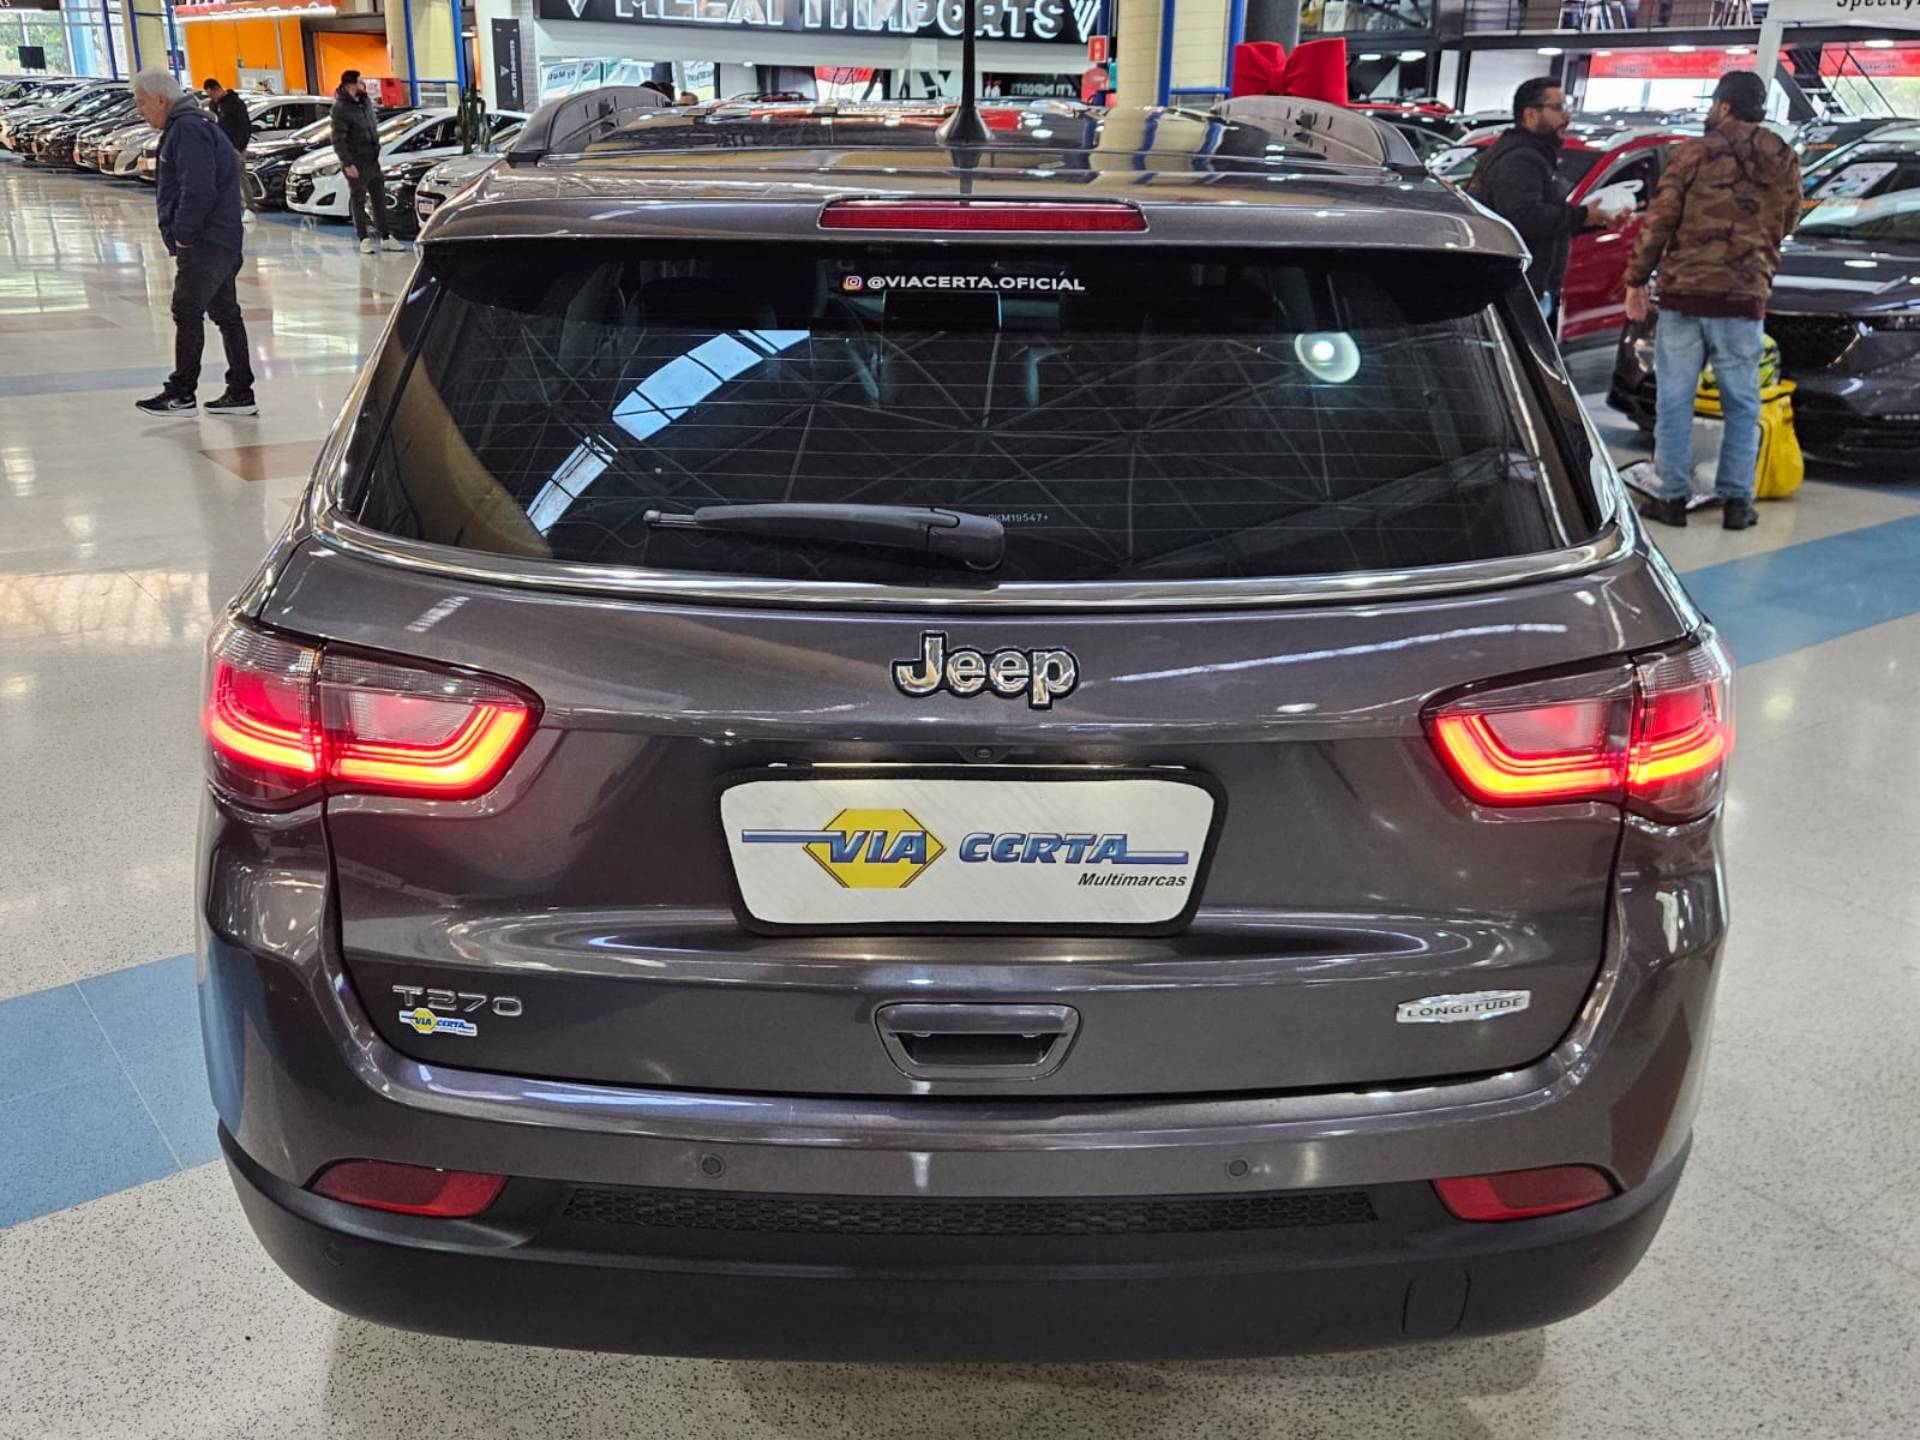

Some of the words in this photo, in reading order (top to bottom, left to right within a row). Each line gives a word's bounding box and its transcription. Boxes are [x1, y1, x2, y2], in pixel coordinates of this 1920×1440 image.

[867, 276, 1085, 291] @VIACERTA.OFICIAL
[893, 632, 1078, 708] Jeep
[828, 830, 927, 865] VIA
[959, 833, 1128, 864] CERTA
[1078, 873, 1187, 887] Multimarcas
[392, 984, 522, 1016] T270
[1407, 997, 1523, 1017] LONGITUDE
